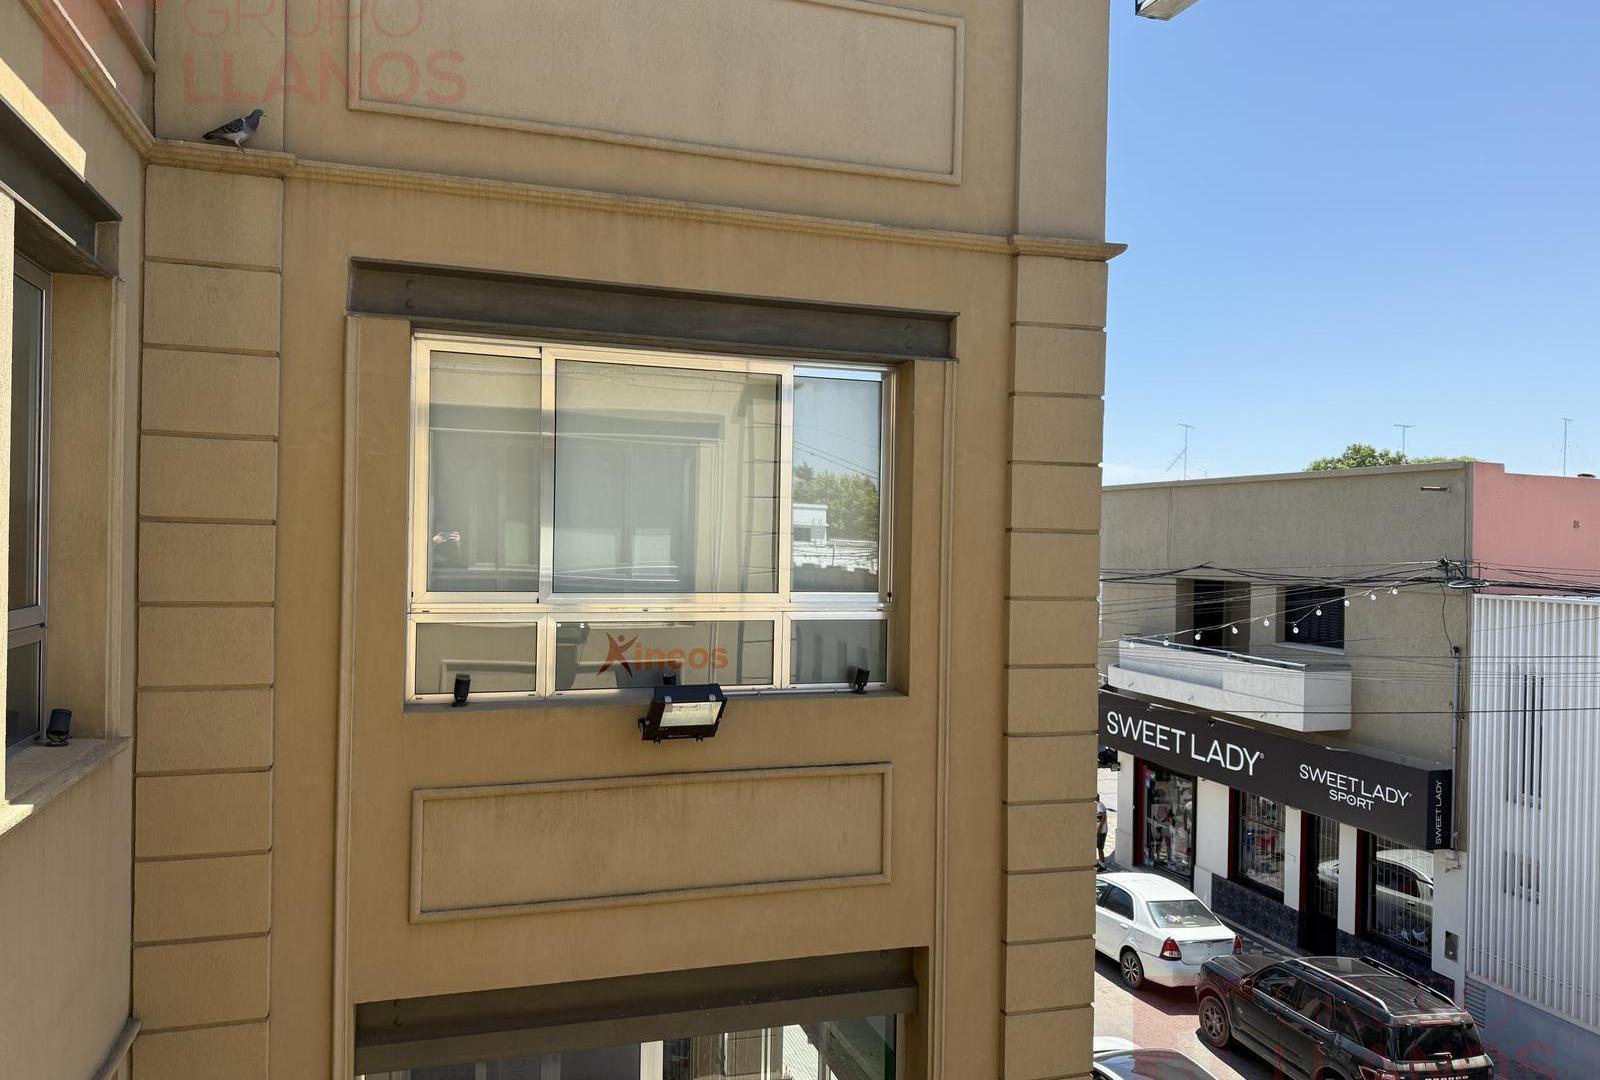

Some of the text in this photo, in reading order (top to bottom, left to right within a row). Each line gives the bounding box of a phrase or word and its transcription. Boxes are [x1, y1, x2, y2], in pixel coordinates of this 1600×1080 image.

[1106, 710, 1186, 755] SWEET
[1299, 763, 1360, 793] SWEET
[1329, 789, 1375, 811] SPORT
